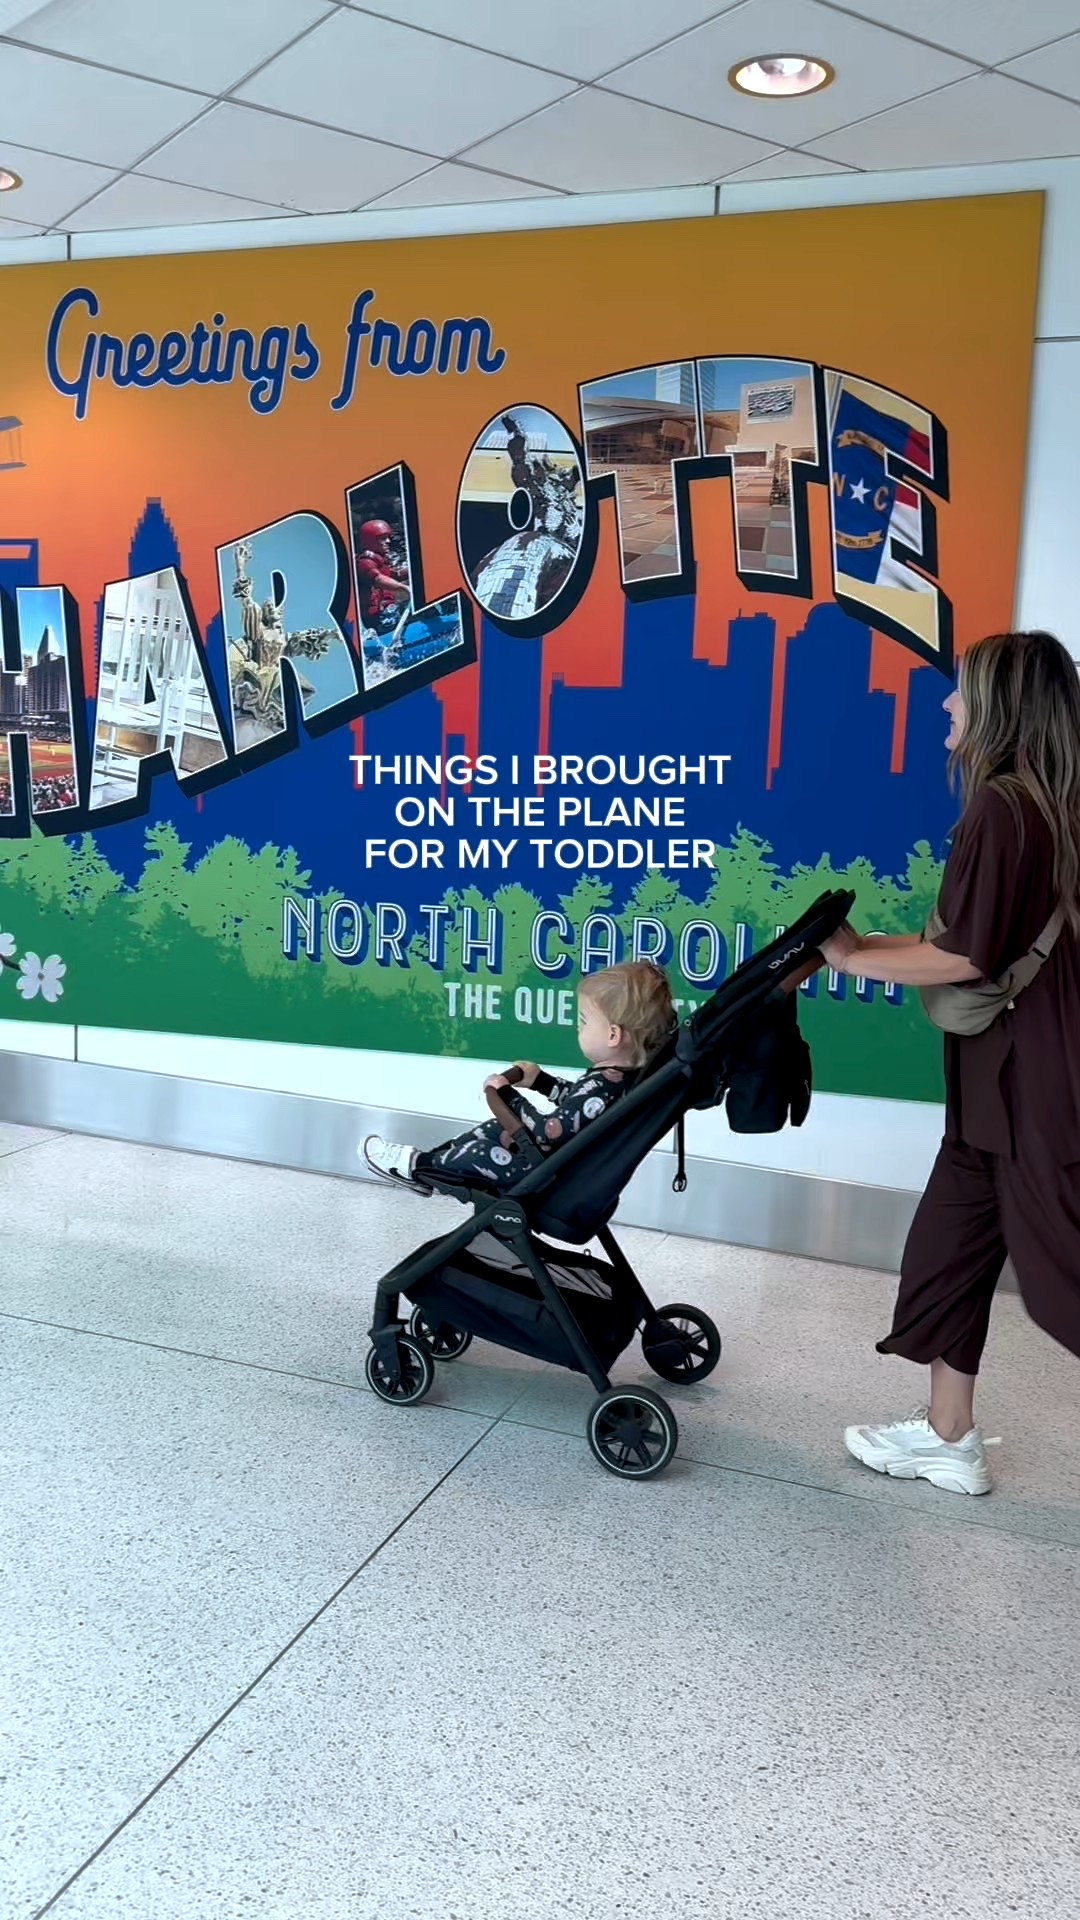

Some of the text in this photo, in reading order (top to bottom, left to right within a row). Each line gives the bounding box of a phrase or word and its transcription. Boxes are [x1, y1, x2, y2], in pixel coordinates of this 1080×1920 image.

[46, 287, 506, 420] Greetings from
[0, 355, 952, 840] HARLOTTE
[282, 896, 504, 976] NORTH
[767, 941, 806, 970] nuna
[444, 982, 577, 1026] THE QUE
